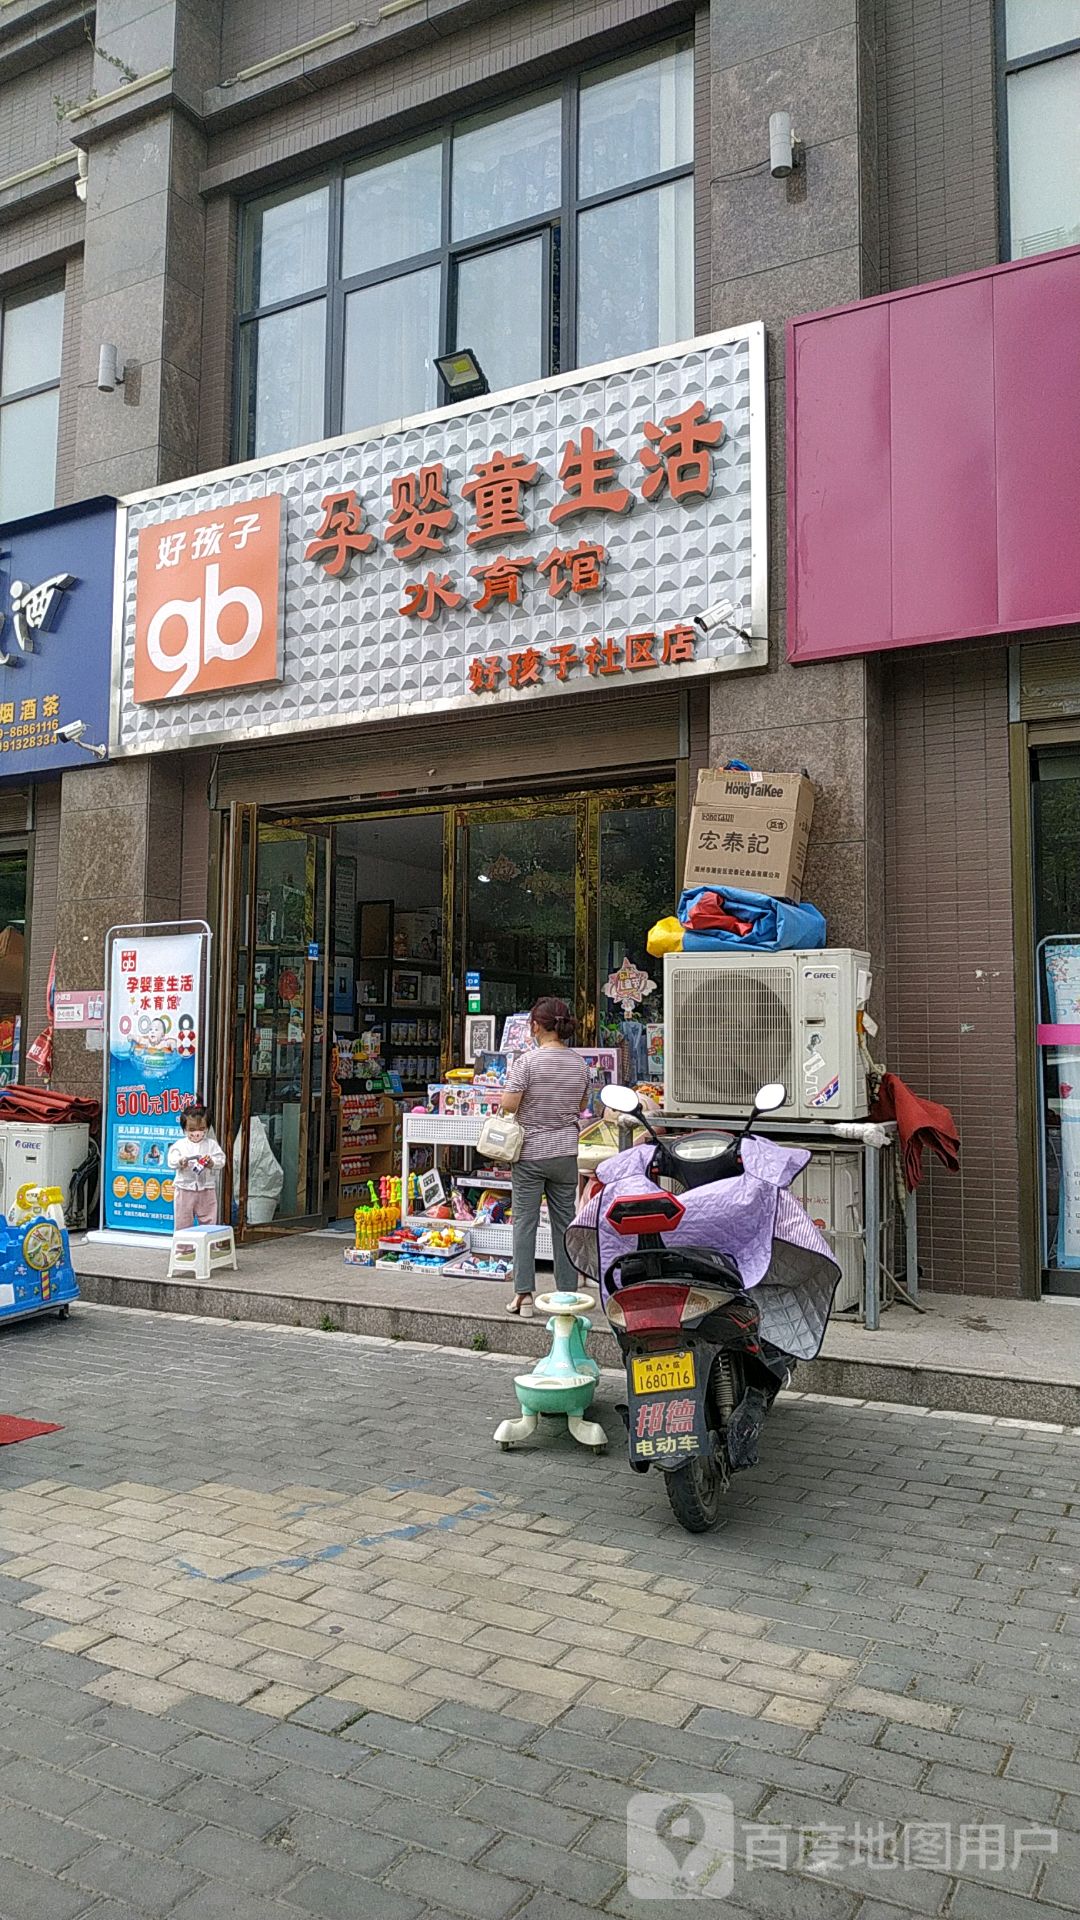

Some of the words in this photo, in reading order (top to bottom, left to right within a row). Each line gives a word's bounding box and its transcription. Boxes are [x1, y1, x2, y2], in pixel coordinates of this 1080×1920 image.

[305, 400, 725, 577] 孕婴童生活
[155, 513, 261, 570] 好孩子
[400, 540, 606, 621] 水育馆
[147, 563, 263, 698] gb
[469, 624, 697, 694] 好孩子社区店
[725, 781, 784, 798] HongTaiKee
[698, 830, 769, 854] 宏泰記
[127, 975, 193, 993] 孕婴童生活
[140, 995, 178, 1010] 水育馆
[639, 1371, 690, 1390] 1680716
[635, 1399, 696, 1437] 邦德
[635, 1434, 700, 1456] 电动车
